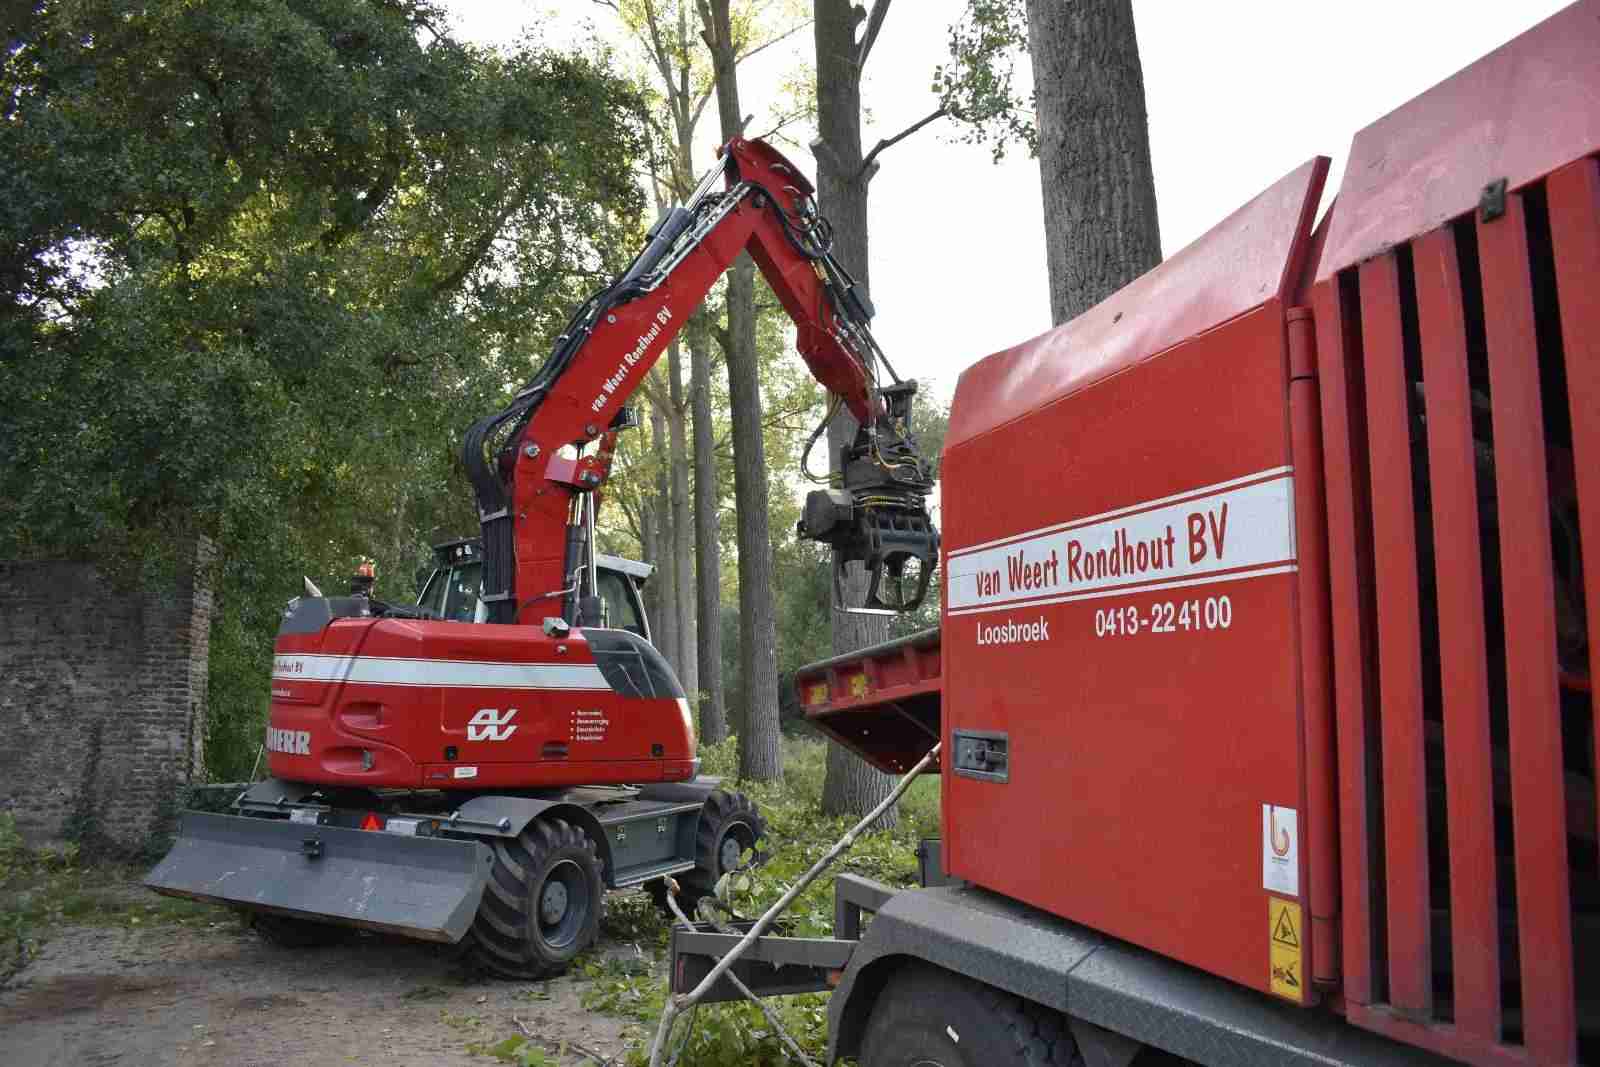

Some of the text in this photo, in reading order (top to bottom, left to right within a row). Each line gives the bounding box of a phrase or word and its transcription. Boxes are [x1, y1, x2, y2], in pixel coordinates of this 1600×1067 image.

[592, 305, 672, 412] van Weert Rondhout BV
[976, 501, 1228, 598] van Weert Rondhout BV
[976, 616, 1049, 645] Loosbroek
